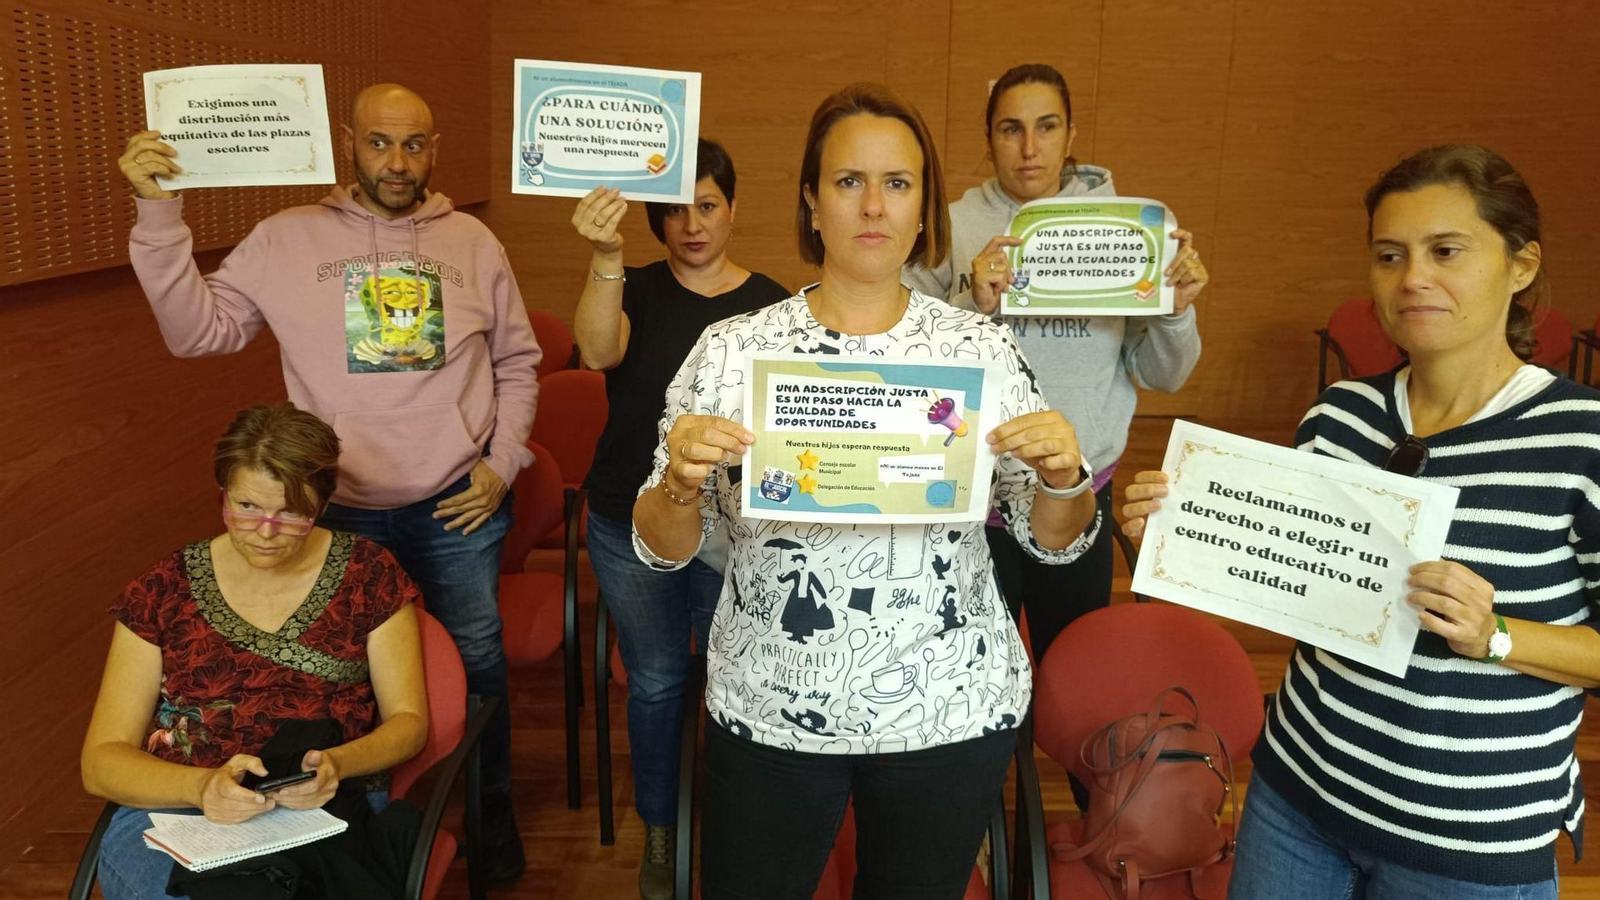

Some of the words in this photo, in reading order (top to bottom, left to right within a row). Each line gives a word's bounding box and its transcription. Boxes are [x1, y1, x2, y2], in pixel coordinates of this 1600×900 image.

[188, 99, 249, 110] Exigimos
[252, 99, 277, 107] una
[542, 97, 595, 110] ¿PARA
[600, 99, 663, 115] CUÁNDO
[179, 113, 260, 125] distribución
[264, 113, 290, 122] más
[540, 115, 573, 127] UNA
[576, 117, 664, 134] SOLUCIÓN?
[161, 130, 228, 141] equitativa
[231, 130, 245, 138] de
[248, 129, 267, 137] las
[271, 129, 310, 139] plazas
[538, 132, 589, 143] Nuestr@s
[591, 135, 619, 147] hij@s
[620, 139, 666, 149] merecen
[207, 144, 269, 154] escolares
[564, 146, 584, 154] una
[586, 147, 639, 159] respuesta
[1037, 229, 1060, 238] UNA
[1062, 227, 1144, 238] ADSCRIPCIÓN
[1036, 243, 1074, 251] JUSTA
[1077, 243, 1092, 251] ES
[1094, 243, 1110, 251] UN
[1113, 243, 1143, 251] PASO
[1021, 256, 1056, 264] HACIA
[1060, 256, 1074, 264] LA
[1077, 256, 1137, 264] IGUALDAD
[1139, 256, 1156, 264] DE
[1037, 269, 1136, 278] OPORTUNIDADES
[1034, 318, 1092, 338] YORK
[776, 384, 800, 393] UNA
[803, 385, 886, 396] ADSCRIPCIÓN
[889, 388, 929, 397] JUSTA
[776, 395, 791, 403] ES
[794, 396, 810, 404] UN
[813, 397, 843, 405] PASO
[847, 398, 884, 407] HACIA
[887, 399, 902, 407] LA
[775, 406, 836, 416] IGUALDAD
[839, 409, 856, 417] DE
[775, 418, 876, 430] OPORTUNIDADES
[842, 443, 872, 452] esperan
[872, 445, 910, 453] respuesta
[819, 461, 839, 469] Consejo
[1207, 480, 1346, 529] Reclamamos
[1350, 517, 1371, 535] el
[1180, 500, 1264, 532] derecho
[1268, 524, 1281, 536] a
[1286, 529, 1354, 556] elegir
[1359, 550, 1389, 569] un
[1174, 524, 1242, 551] centro
[1246, 543, 1351, 584] educativo
[1356, 575, 1383, 593] de
[1227, 564, 1308, 597] calidad
[761, 643, 837, 668] PRACTICALLY
[773, 661, 820, 687] PERFECT
[770, 682, 800, 704] every
[804, 690, 832, 707] way
